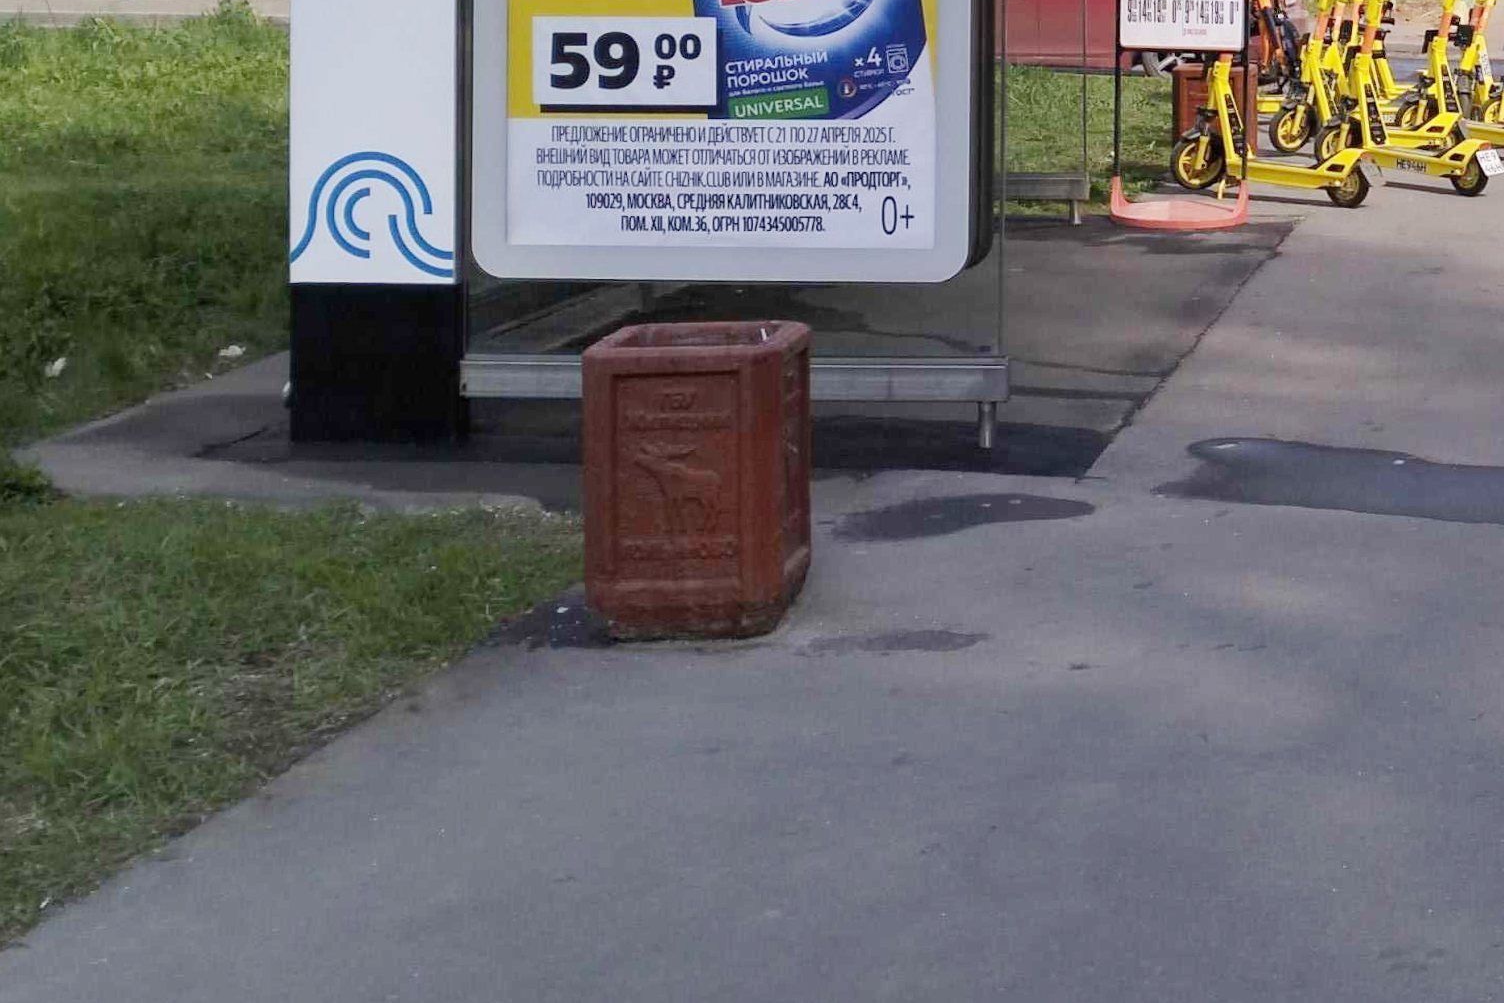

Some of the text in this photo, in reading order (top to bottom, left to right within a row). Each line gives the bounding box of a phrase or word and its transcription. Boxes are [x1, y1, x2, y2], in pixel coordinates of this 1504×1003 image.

[549, 31, 702, 90] 59 00
[725, 49, 828, 74] СТИРАЛЬНЫЙ
[727, 69, 809, 89] ПОРОШОК
[735, 96, 824, 118] UNIVERSAL
[551, 125, 628, 145] ПРЕДЛОЖЕНИЕ
[629, 126, 696, 143] ОГРАНИЧЕНО
[699, 126, 706, 143] И
[708, 123, 766, 146] ДЕЙСТВУЕТ
[767, 126, 775, 144] С
[776, 126, 786, 144] 21
[790, 126, 805, 144] ПО
[807, 126, 819, 144] 27
[820, 126, 860, 144] АПРЕЛЯ
[863, 126, 887, 144] 2025
[536, 145, 588, 165] ВНЕШНИЙ
[590, 148, 611, 167] ВИД
[612, 148, 650, 166] ТОВАРА
[652, 148, 689, 166] МОЖЕТ
[691, 148, 756, 166] ОТЛИЧАТЬСЯ
[758, 149, 772, 166] ОТ
[773, 145, 851, 166] ИЗОБРАЖЕНИЙ
[852, 149, 859, 166] В
[537, 170, 613, 189] ПОДРОБНОСТИ
[615, 171, 629, 187] НА
[631, 167, 663, 187] САЙТЕ
[664, 171, 731, 188] CHIZHIK.CLUB
[732, 171, 755, 188] ИЛИ
[757, 172, 764, 188] В
[823, 172, 839, 188] АО
[586, 193, 625, 212] 109029,
[627, 194, 675, 212] МОСКВА,
[677, 194, 726, 212] СРЕДНЯЯ
[727, 194, 831, 212] КАЛИТНИКОВСКАЯ,
[621, 215, 648, 232] ПОМ.
[667, 216, 710, 234] КОМ.36,
[712, 216, 740, 232] ОГРН
[743, 216, 826, 232] 1074345005778.
[881, 196, 915, 235] 0+
